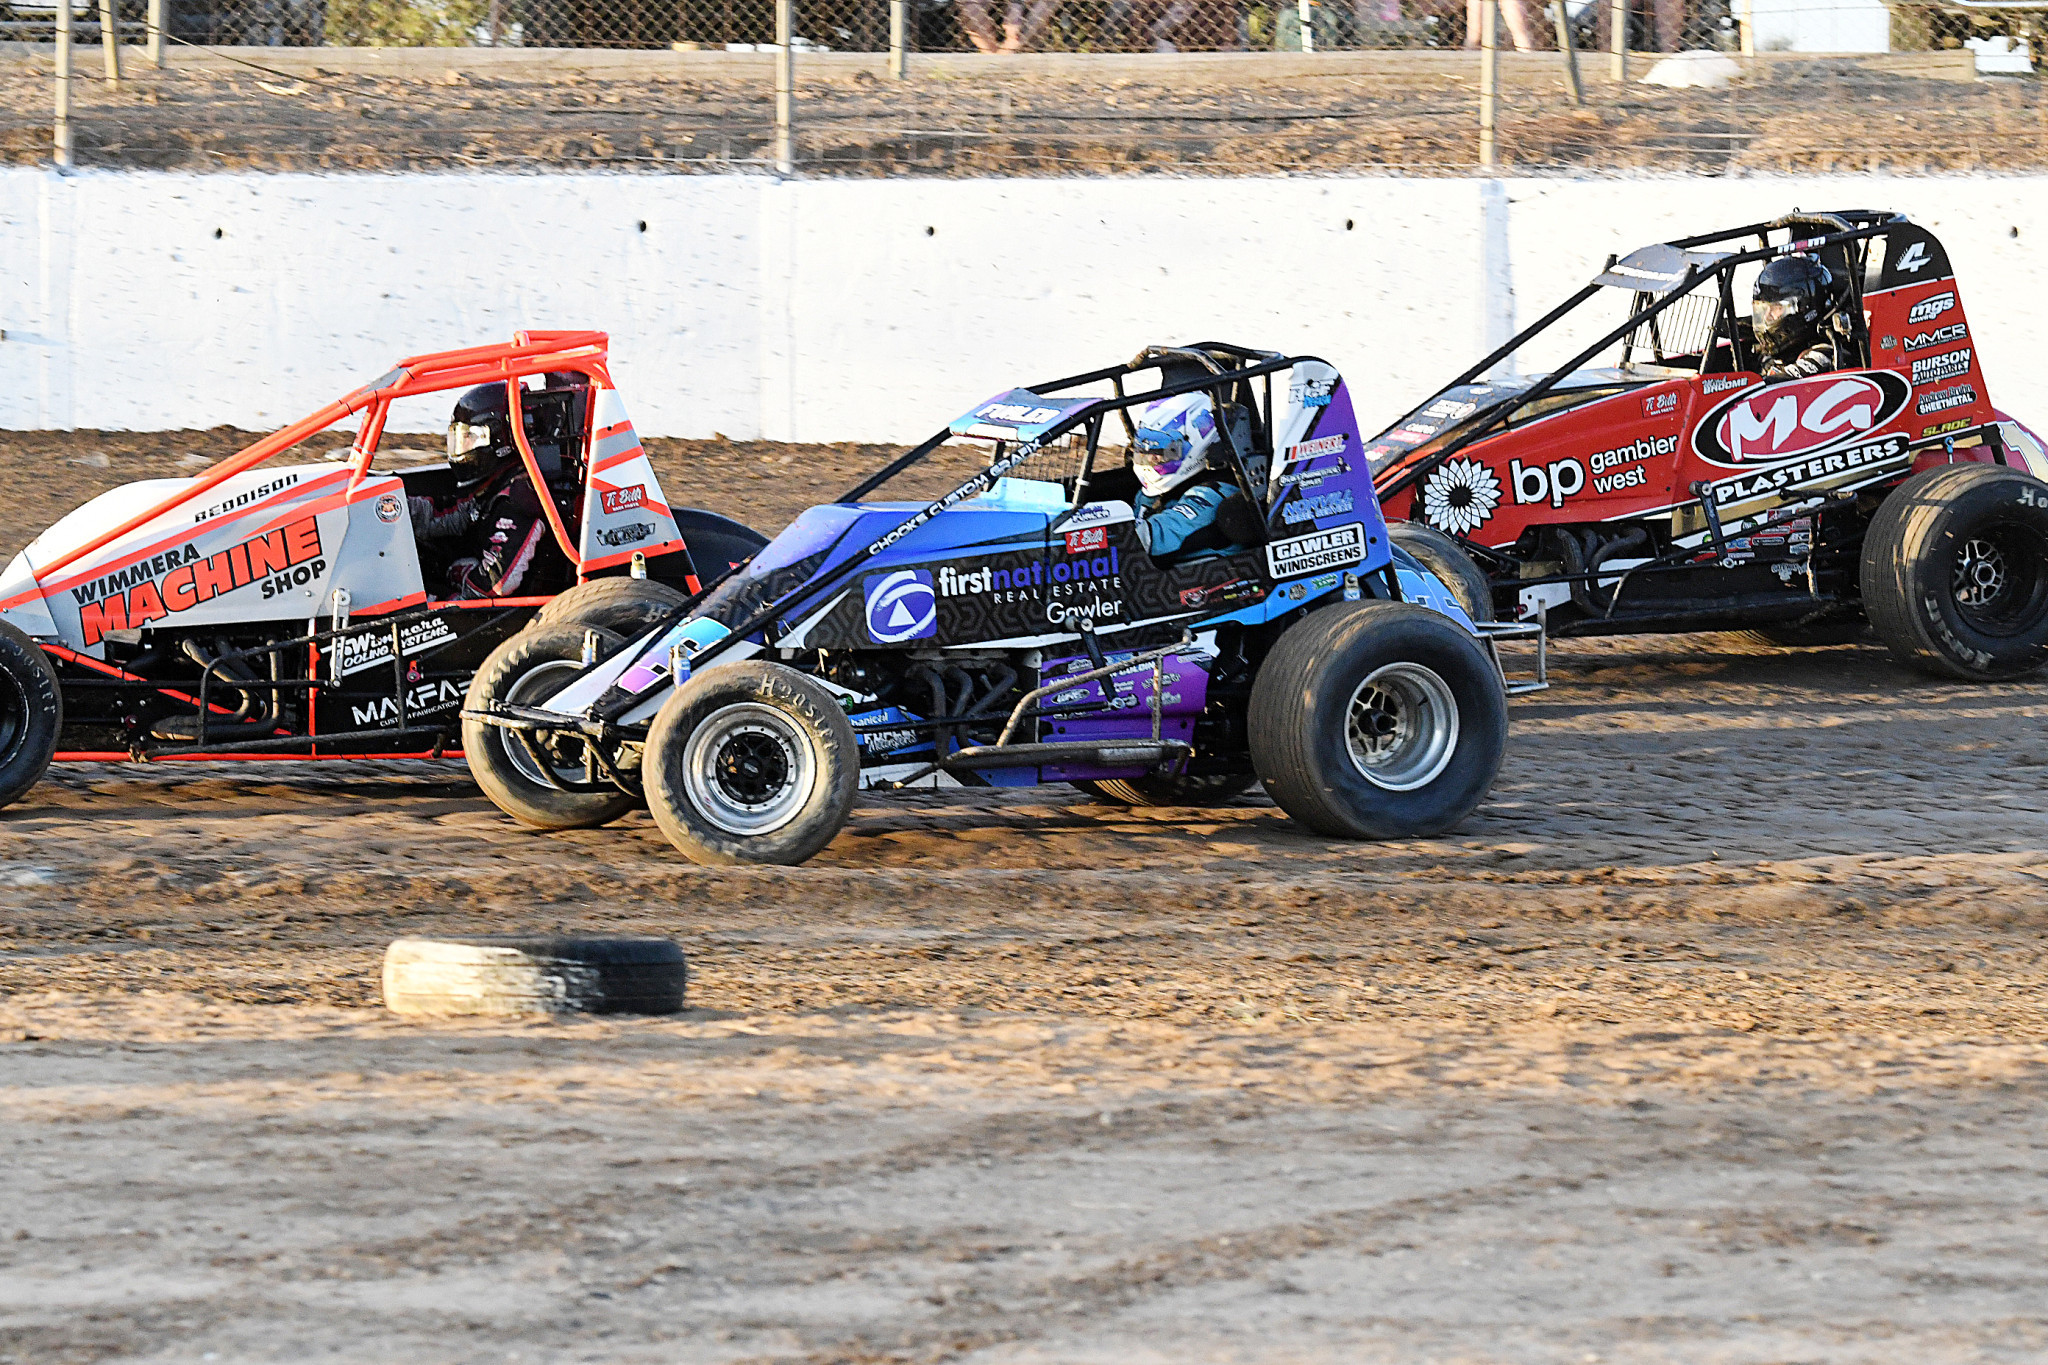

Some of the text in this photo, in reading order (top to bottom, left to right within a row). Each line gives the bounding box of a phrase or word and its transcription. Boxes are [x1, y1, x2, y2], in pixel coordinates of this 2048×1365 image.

[1897, 242, 1931, 272] 4
[1909, 298, 1955, 317] mgs
[1903, 323, 1966, 348] MMCR
[1912, 349, 1971, 373] BURSON
[1920, 393, 1973, 413] SHEETMETAL
[1730, 381, 1873, 461] MG
[1922, 417, 1971, 437] SLADE
[1589, 434, 1678, 473] gambier
[1512, 457, 1584, 508] bp
[1593, 467, 1647, 493] west
[1715, 439, 1901, 503] PLASTERERS
[868, 438, 1043, 556] CHOOKS CUSTOM GRAFIX
[1276, 530, 1356, 560] GAWLER
[71, 543, 201, 605] WIMMERA
[1274, 546, 1361, 576] WINDSCREENS
[78, 515, 323, 647] MACHINE
[261, 559, 327, 600] SHOP
[994, 577, 1121, 604] REAL ESTATE
[1046, 595, 1123, 624] Gawler
[400, 624, 449, 649] YSTEMS
[331, 645, 389, 669] OOLING
[413, 699, 460, 719] FABRICATION
